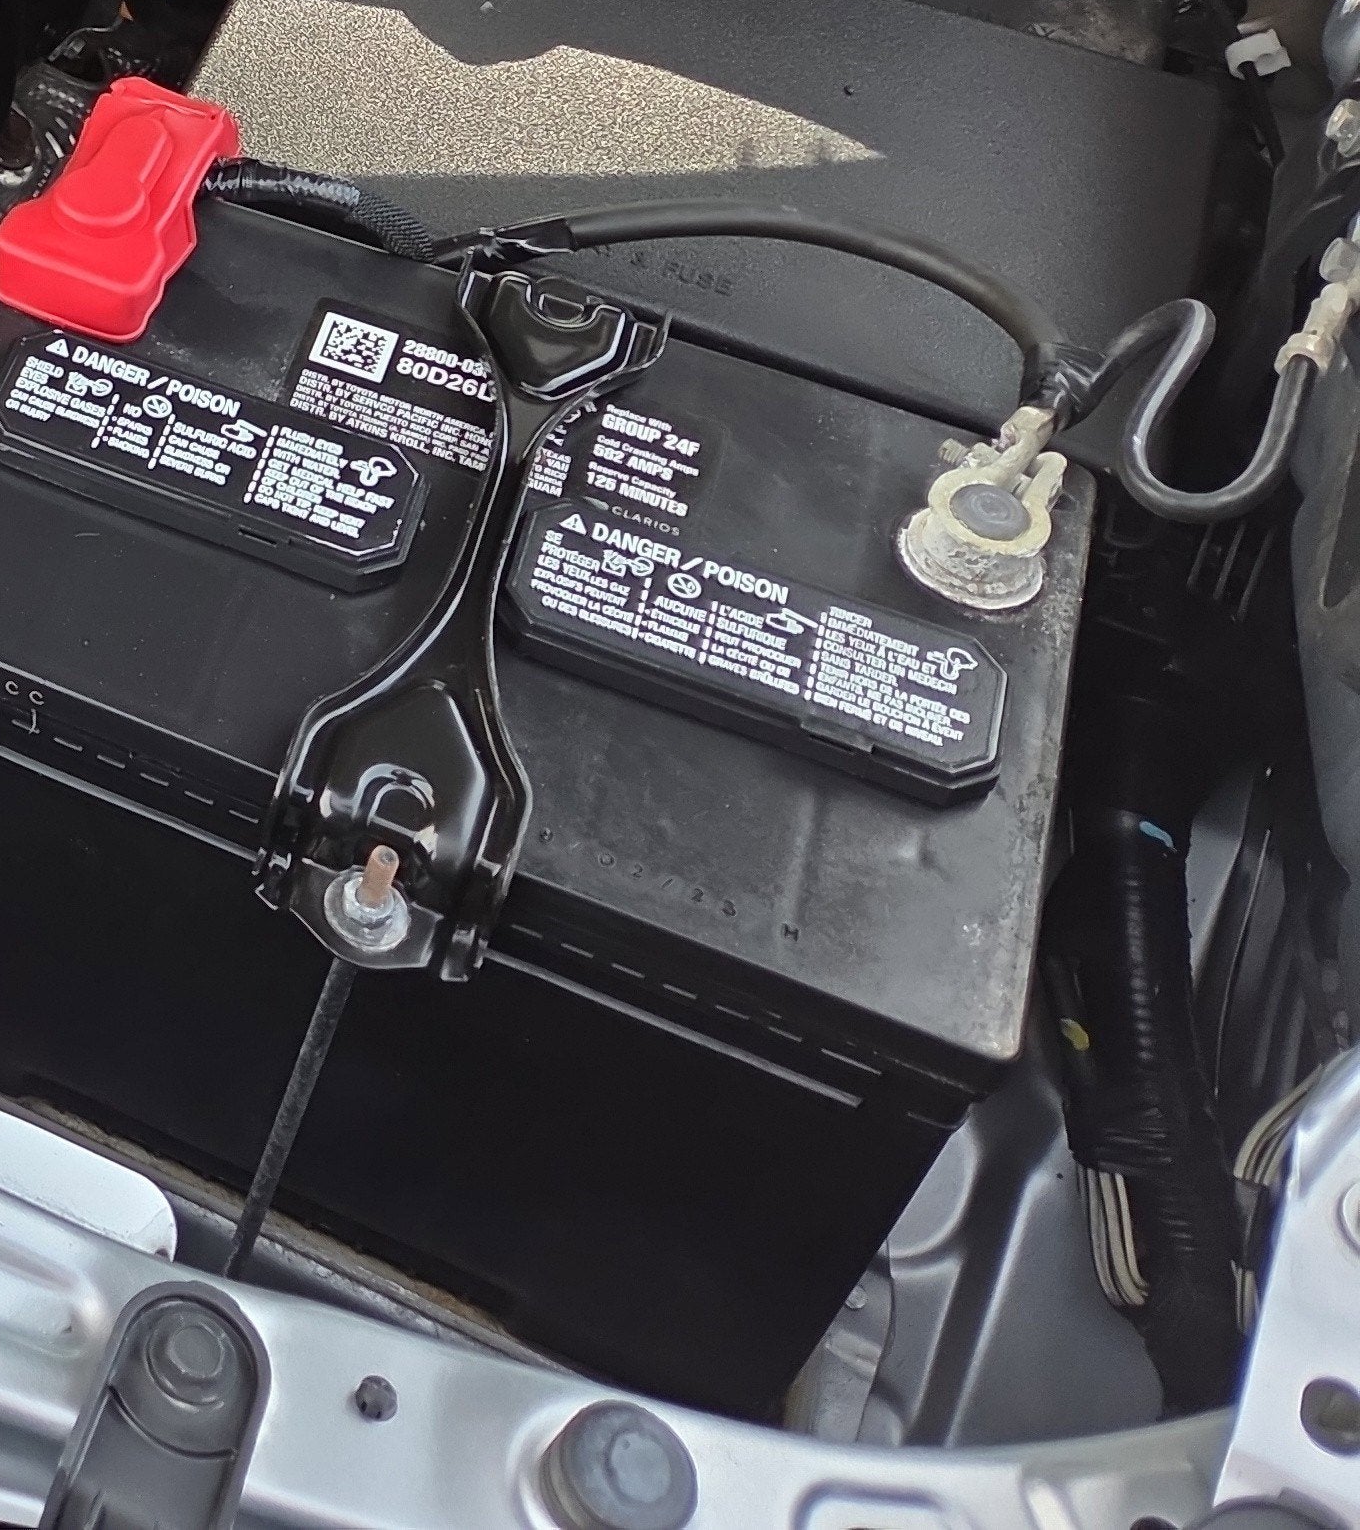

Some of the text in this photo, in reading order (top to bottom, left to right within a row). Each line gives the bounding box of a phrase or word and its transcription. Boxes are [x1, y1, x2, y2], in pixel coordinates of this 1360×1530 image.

[19, 365, 49, 384] EYES
[23, 355, 64, 378] SHIELD
[14, 375, 106, 418] EXPLOSIVE GASES
[122, 402, 142, 418] NO
[601, 412, 661, 443] GROUP
[662, 433, 700, 457] 24F
[605, 403, 672, 432] Replace With
[172, 421, 257, 459] SULFURIC ACID
[596, 434, 699, 476] Cold Cranking Amps
[587, 460, 630, 481] Reserve
[630, 475, 676, 499] Capacity
[625, 455, 673, 481] AMPS
[586, 471, 688, 516] 125 MINUTES
[611, 505, 680, 536] CLARIOS
